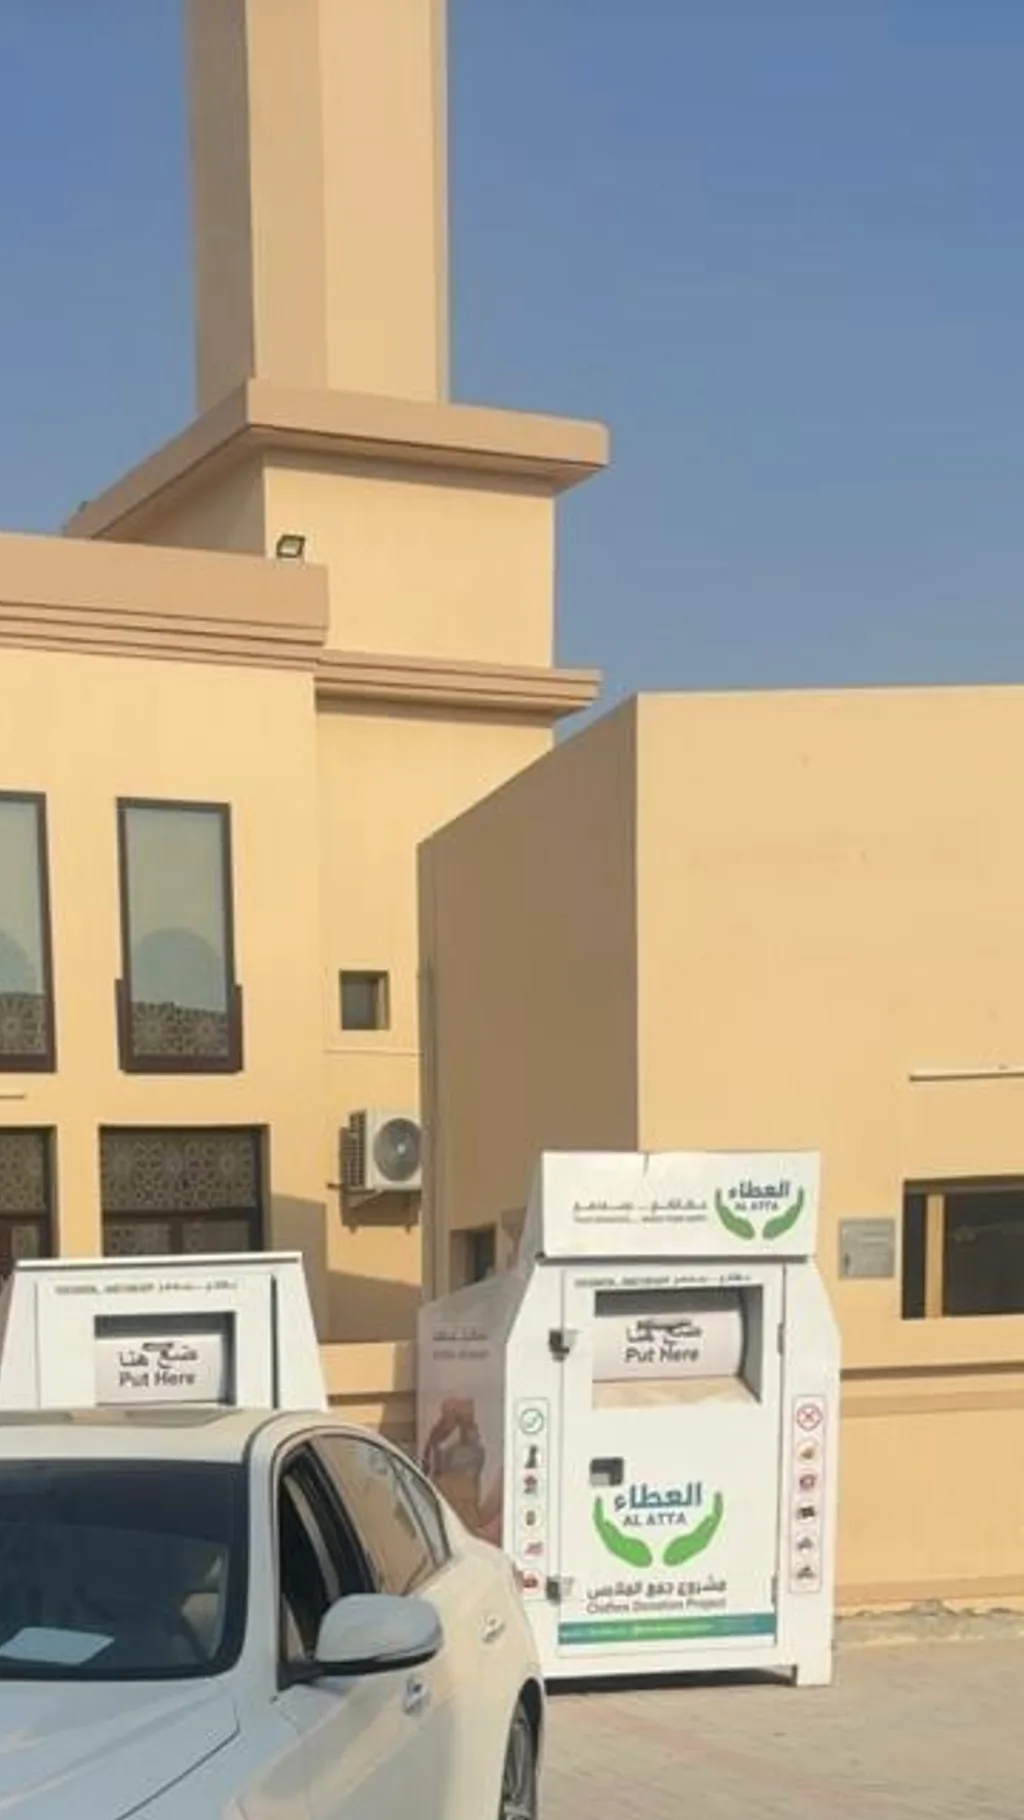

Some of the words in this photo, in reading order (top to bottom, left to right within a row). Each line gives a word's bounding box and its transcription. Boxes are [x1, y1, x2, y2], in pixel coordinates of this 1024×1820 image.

[728, 1180, 791, 1199] العطاء
[625, 1347, 655, 1363] Put
[659, 1347, 699, 1362] Here
[119, 1371, 150, 1387] Put
[154, 1370, 196, 1386] Here
[614, 1481, 702, 1513] العطاء
[623, 1514, 642, 1526] AL
[646, 1511, 688, 1525] ATTA
